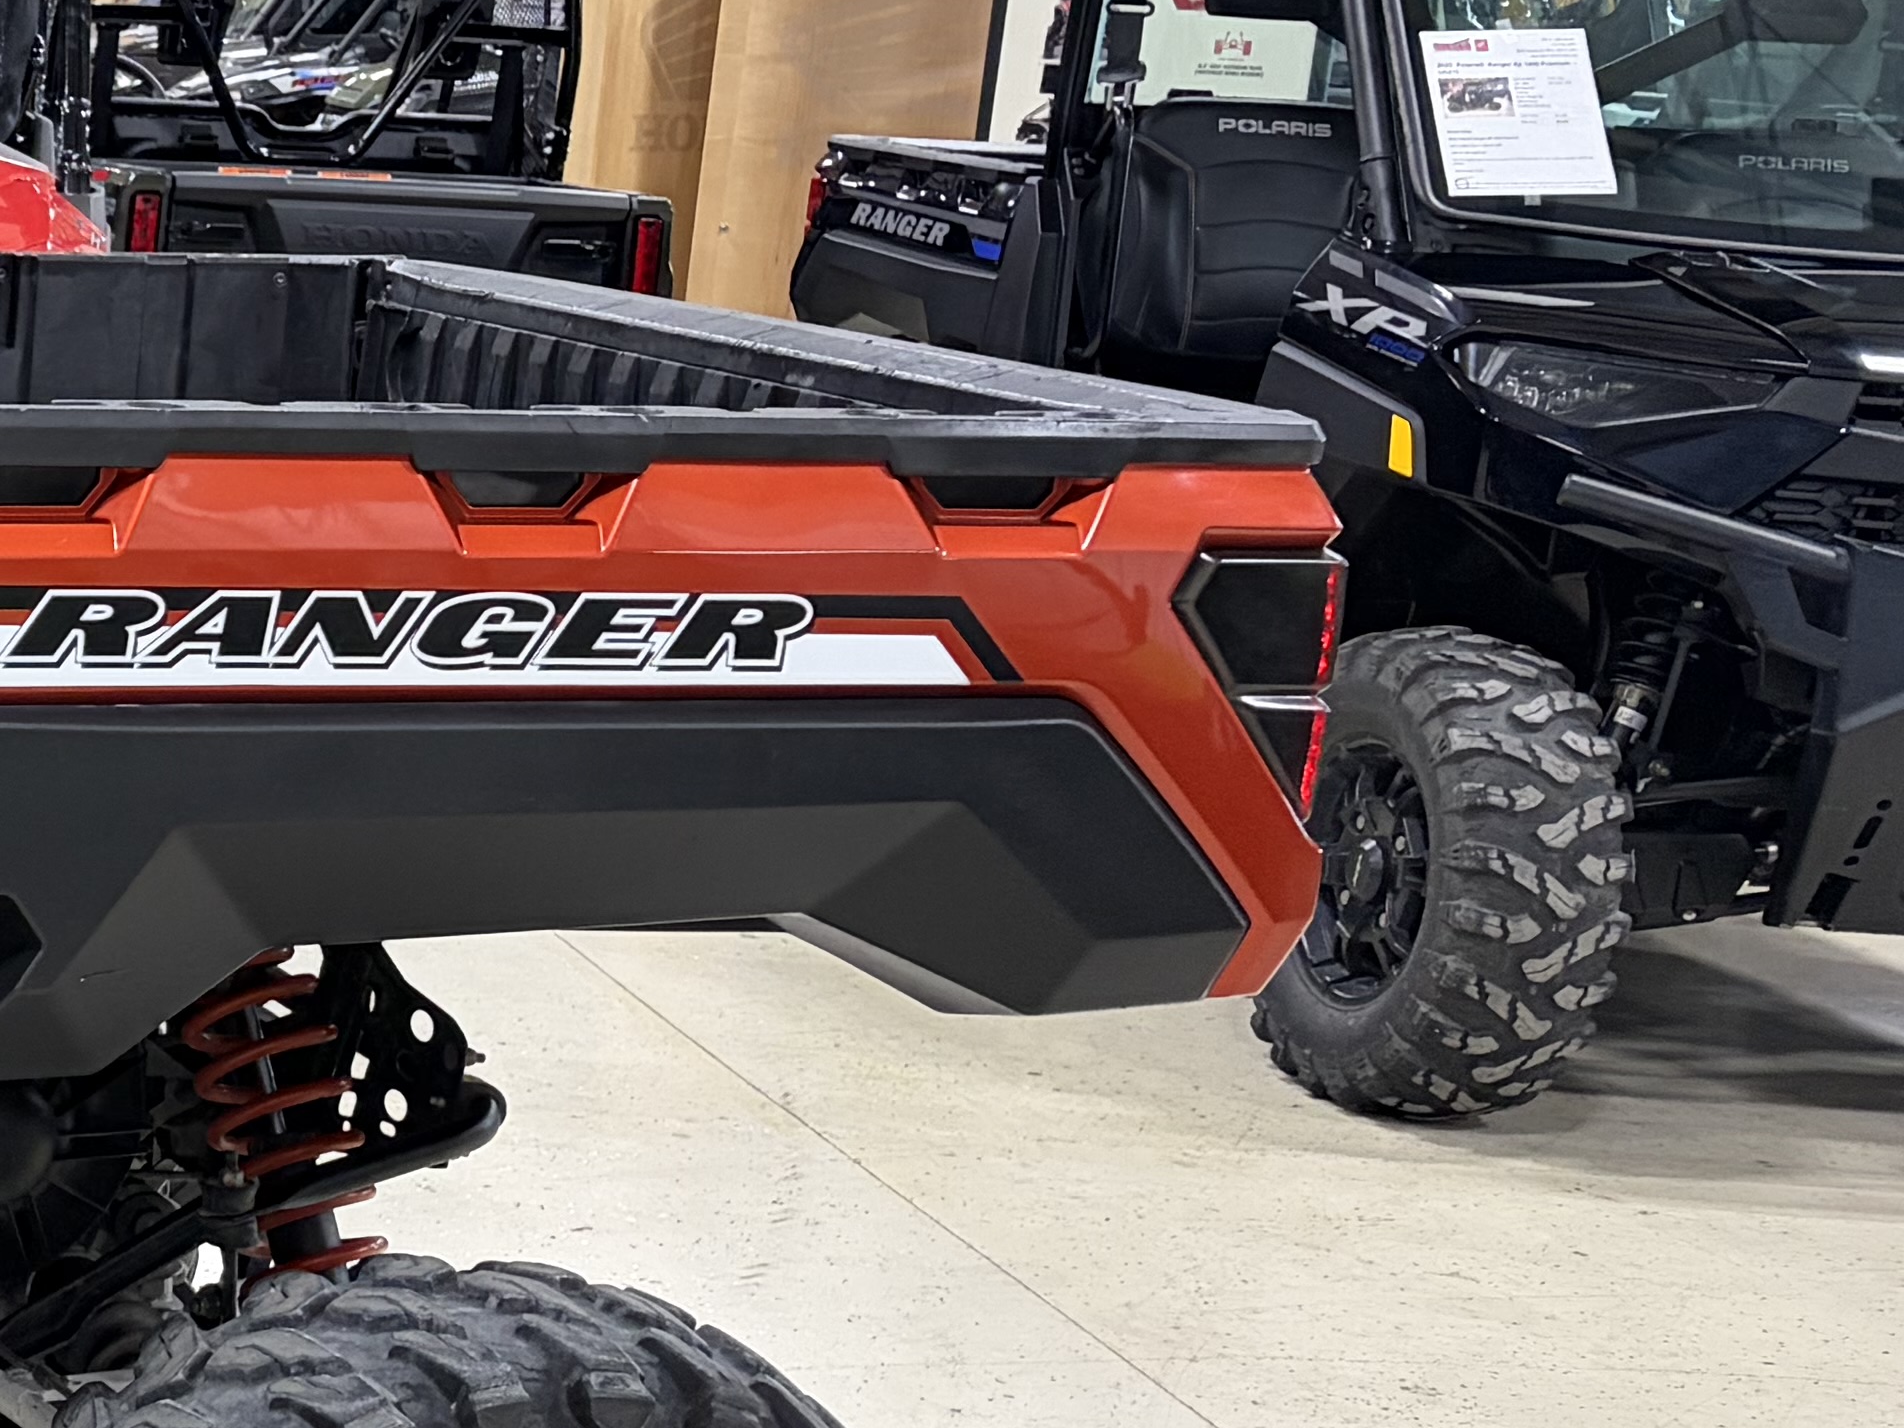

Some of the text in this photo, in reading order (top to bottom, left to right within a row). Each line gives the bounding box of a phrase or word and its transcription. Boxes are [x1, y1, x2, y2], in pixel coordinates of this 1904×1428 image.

[1218, 117, 1332, 137] POLARIS
[1738, 154, 1850, 173] POLARIS
[303, 222, 494, 256] HONDA
[849, 202, 951, 247] RANGER
[1295, 282, 1429, 348] XP
[1367, 332, 1426, 364] 1000
